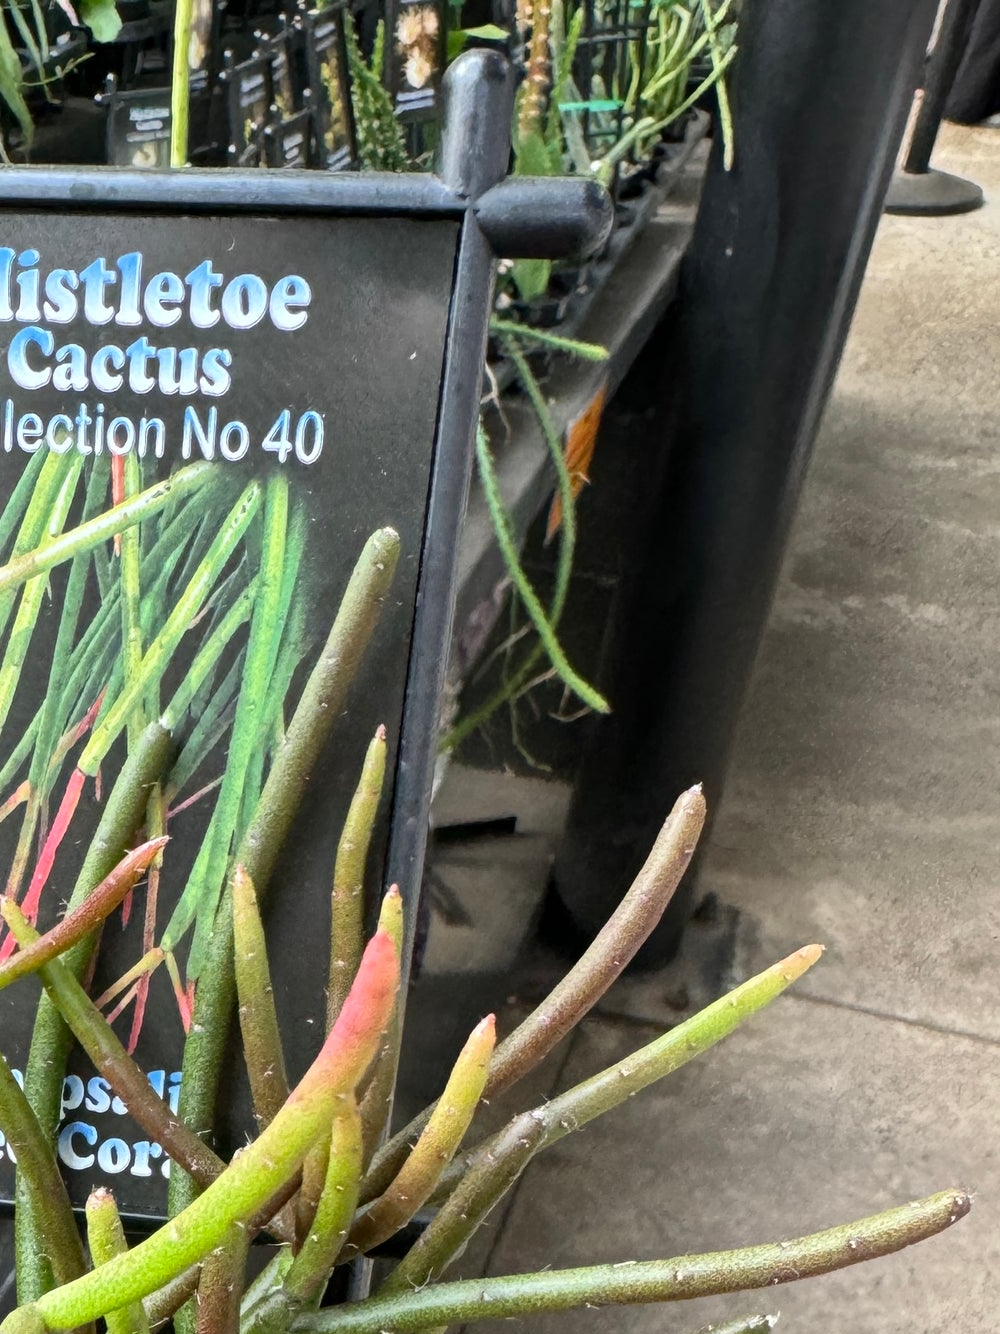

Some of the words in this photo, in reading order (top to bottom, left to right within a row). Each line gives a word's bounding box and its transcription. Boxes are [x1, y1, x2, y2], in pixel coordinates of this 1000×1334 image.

[7, 325, 234, 398] Cactus
[182, 405, 251, 463] No
[262, 409, 325, 465] 40
